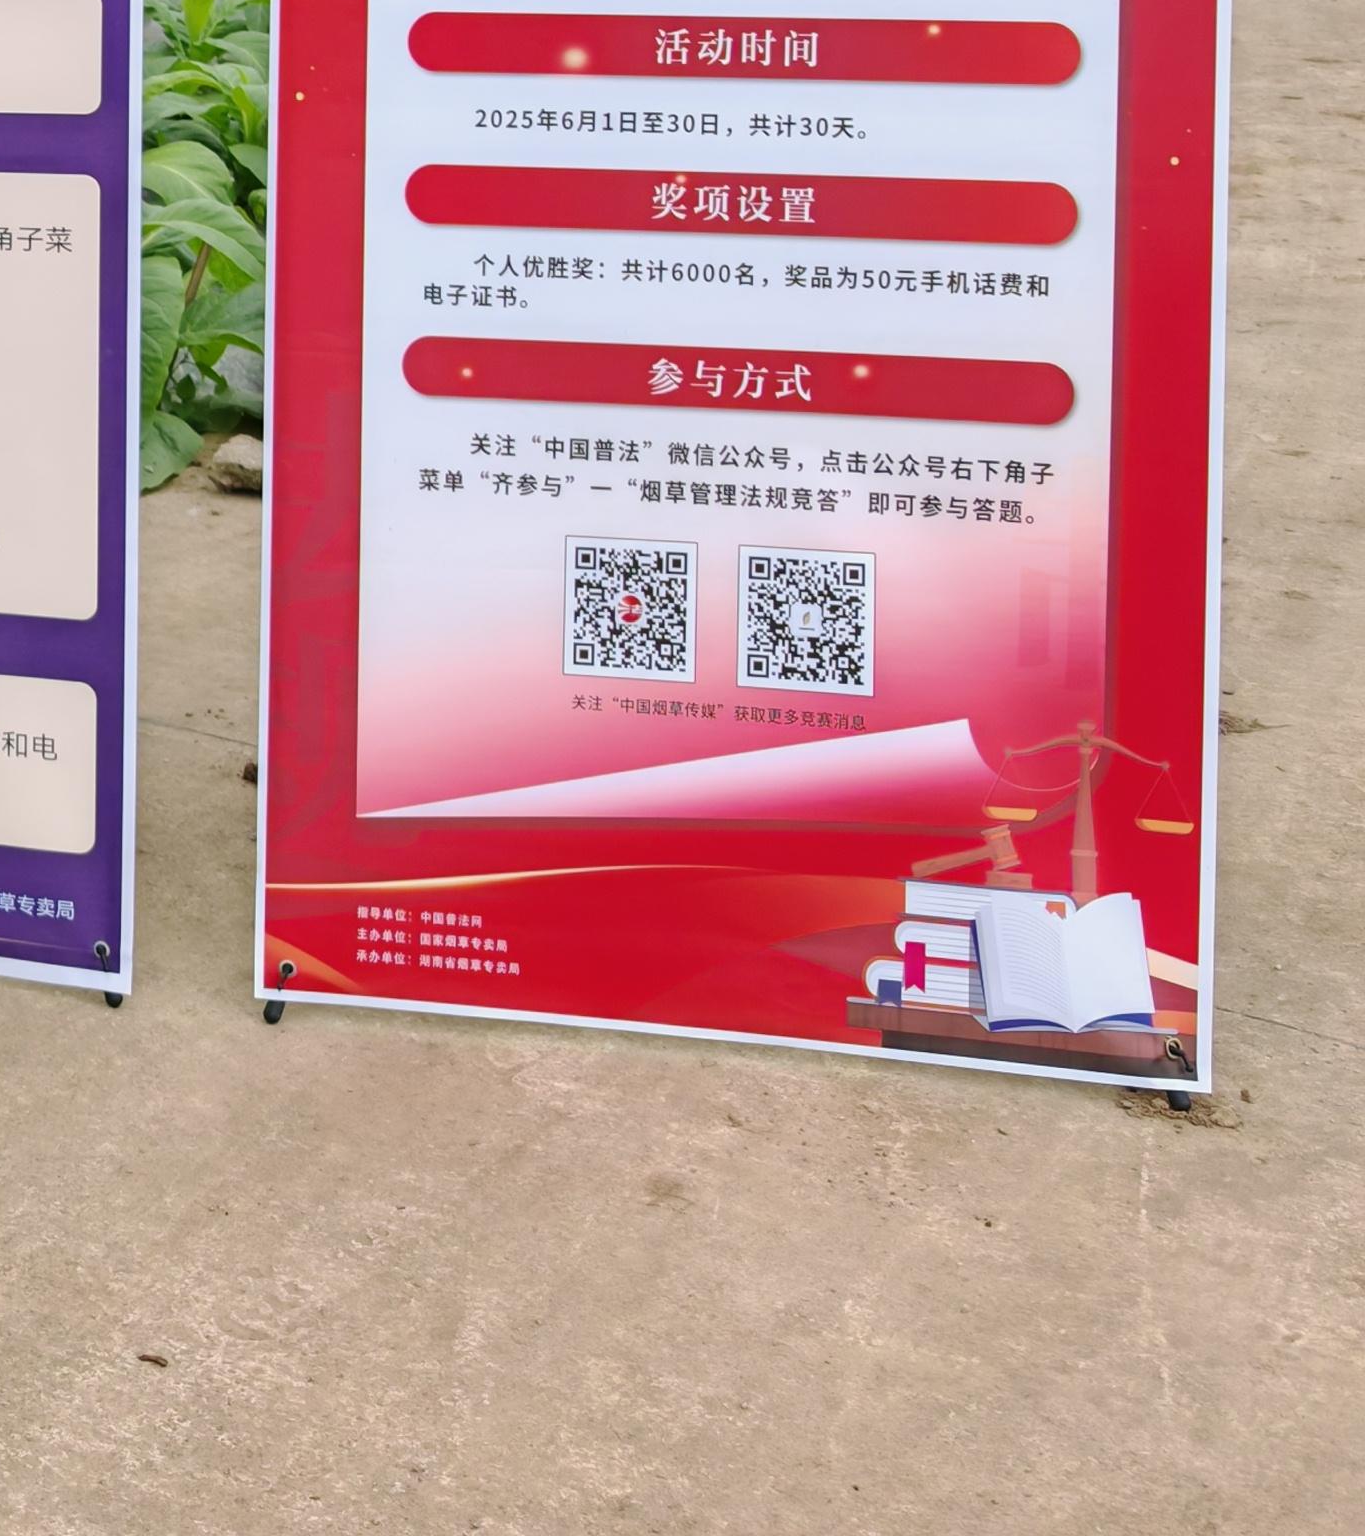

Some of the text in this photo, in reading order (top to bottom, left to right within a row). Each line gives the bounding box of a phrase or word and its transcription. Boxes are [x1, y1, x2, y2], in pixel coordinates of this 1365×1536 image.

[654, 29, 820, 68] 活动时间
[474, 108, 869, 141] 2025年6月1日至30日，共计30天。
[651, 183, 817, 224] 奖项设置
[424, 282, 530, 309] 电子证书。
[473, 254, 1050, 298] 个人优胜奖：共计6000名，奖品为50元手机话费和
[647, 358, 811, 402] 参与方式
